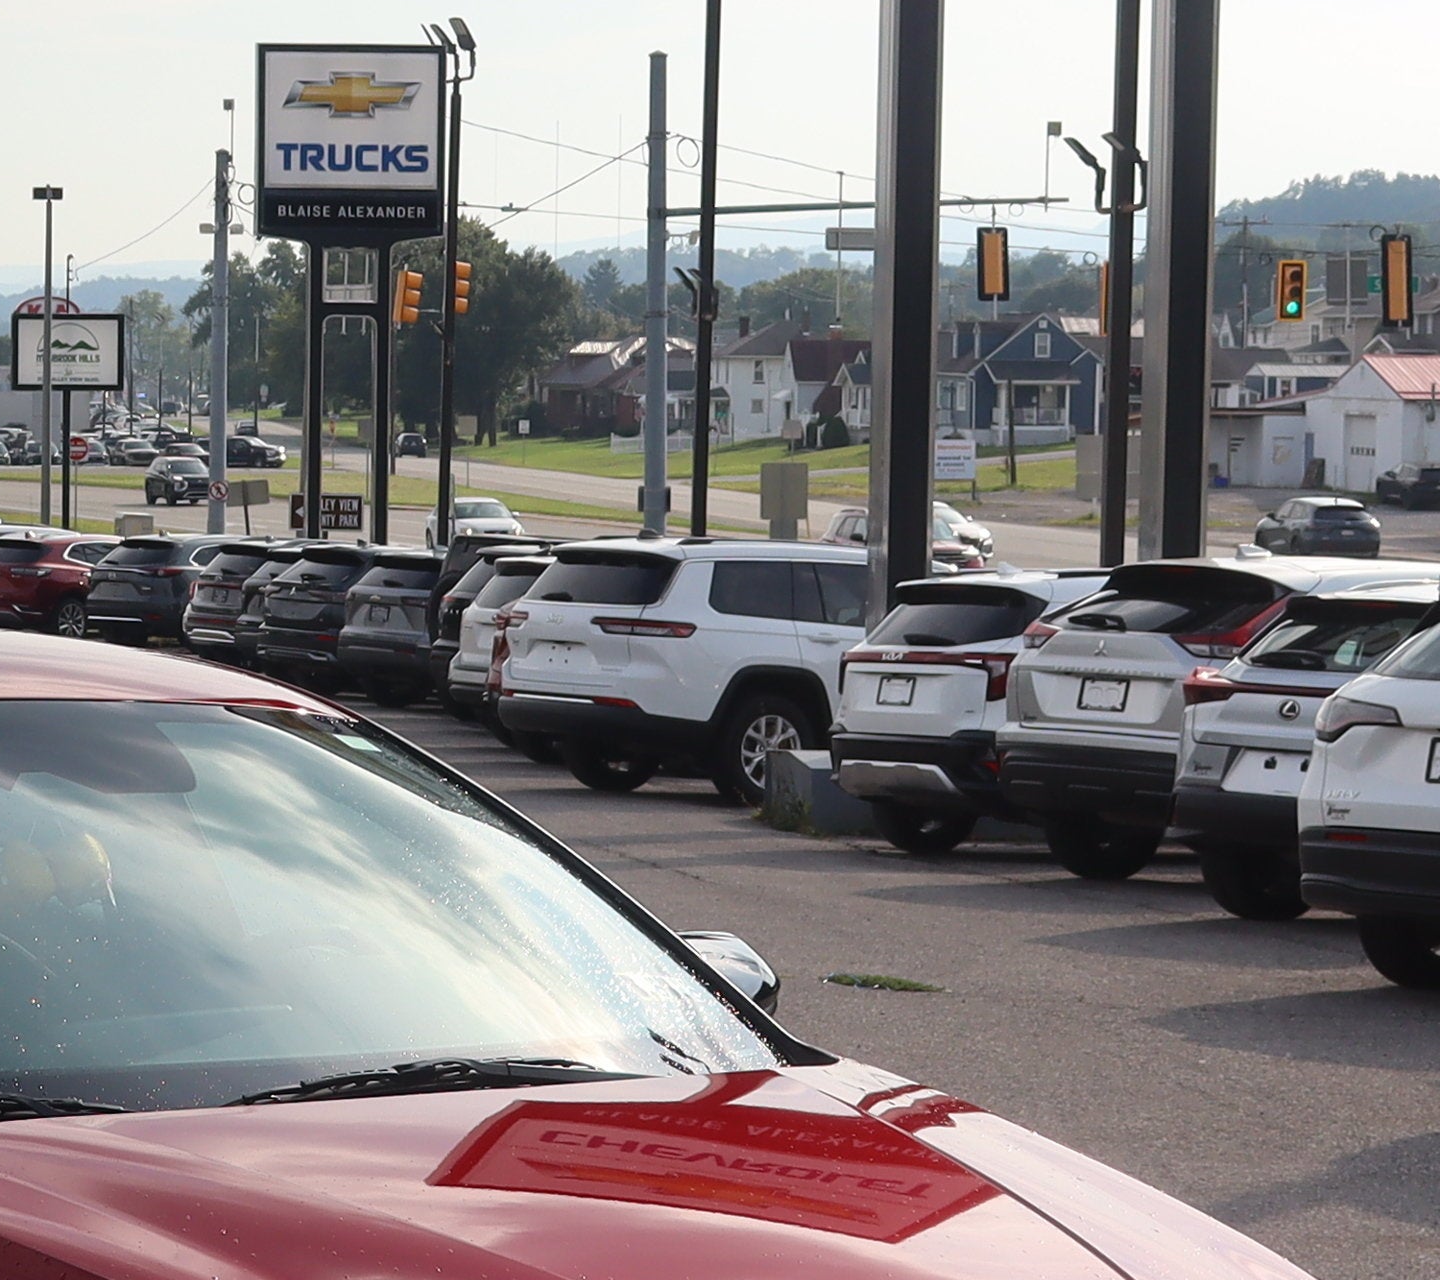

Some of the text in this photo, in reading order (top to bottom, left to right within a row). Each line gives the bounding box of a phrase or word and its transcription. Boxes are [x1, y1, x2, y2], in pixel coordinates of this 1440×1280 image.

[276, 143, 429, 172] TRUCKS
[278, 205, 426, 219] BLAISE ALEXANDER
[339, 514, 359, 527] PARK
